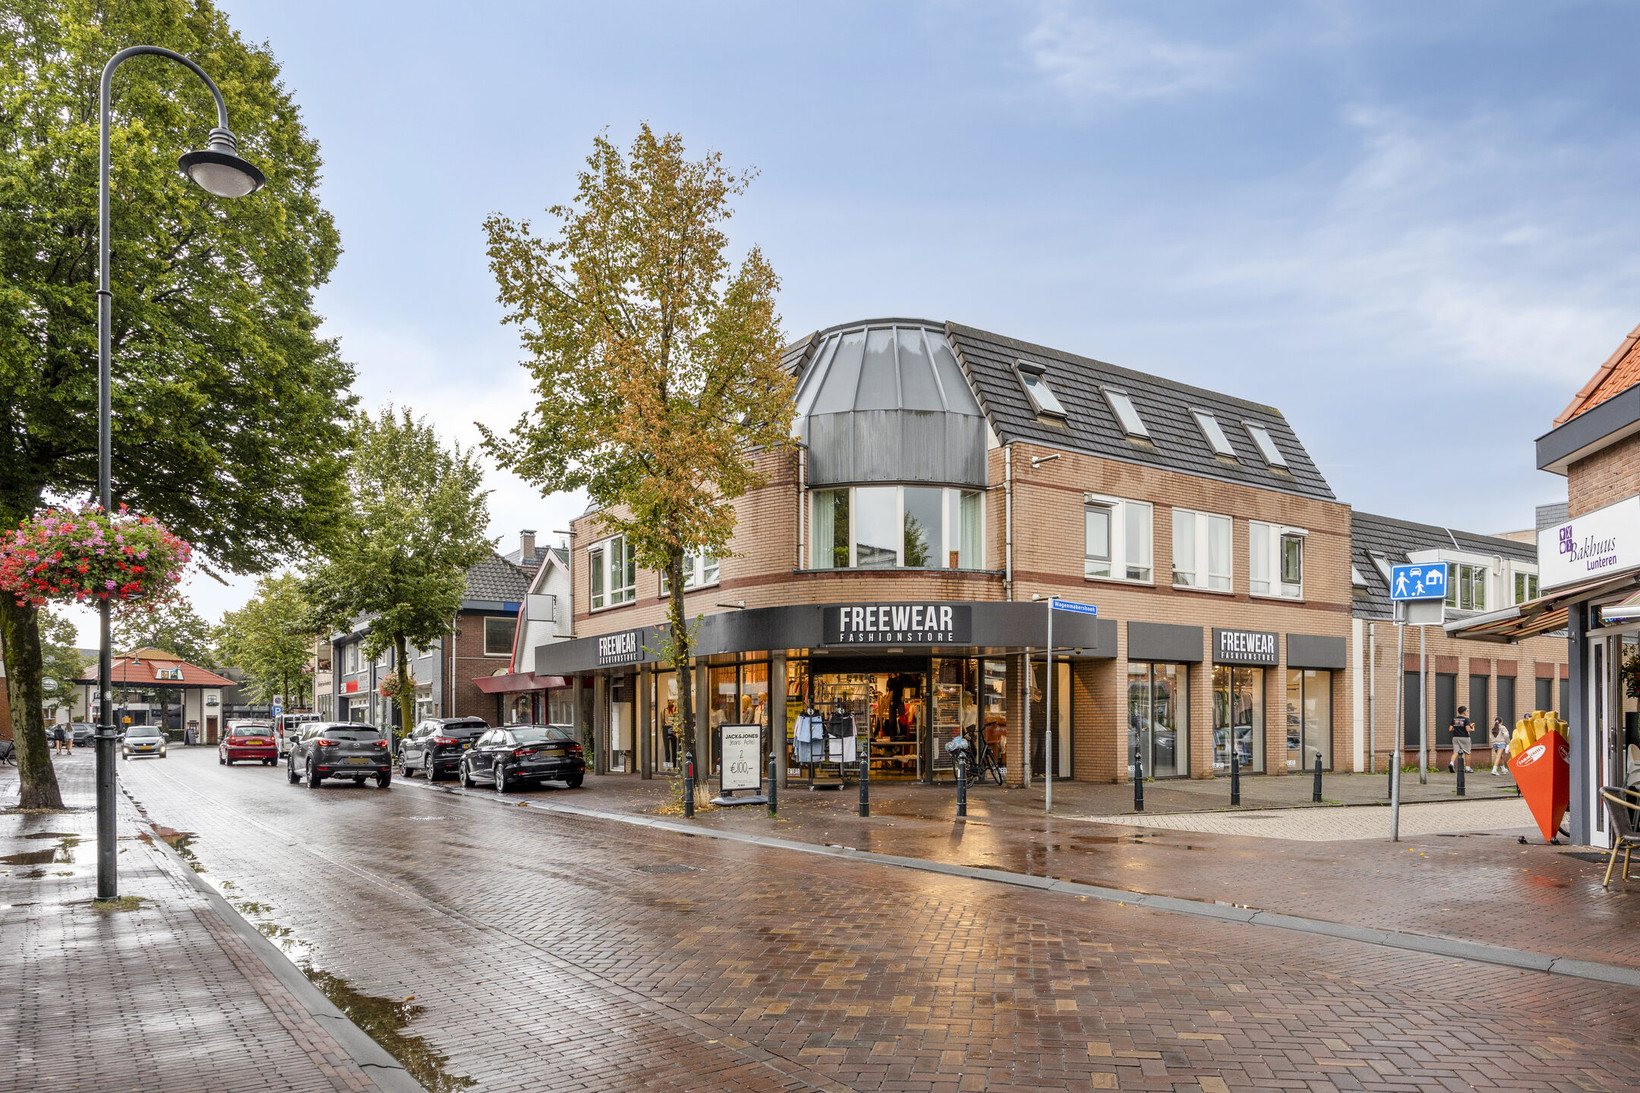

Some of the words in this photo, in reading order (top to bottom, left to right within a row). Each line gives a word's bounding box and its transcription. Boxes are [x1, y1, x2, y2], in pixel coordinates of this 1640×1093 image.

[1569, 535, 1616, 562] Bakhuus
[1586, 555, 1617, 571] Lunteren
[1054, 601, 1096, 612] Wagenmakershoek
[840, 606, 953, 631] FREEWEAR
[840, 632, 953, 642] FASHIONSTORE
[1221, 631, 1274, 653] FREEWEAR
[599, 632, 636, 657] FREEWEAR
[599, 653, 637, 664] FASHIONSTORE
[1221, 652, 1274, 661] FASHIONSTORE
[275, 707, 281, 716] P
